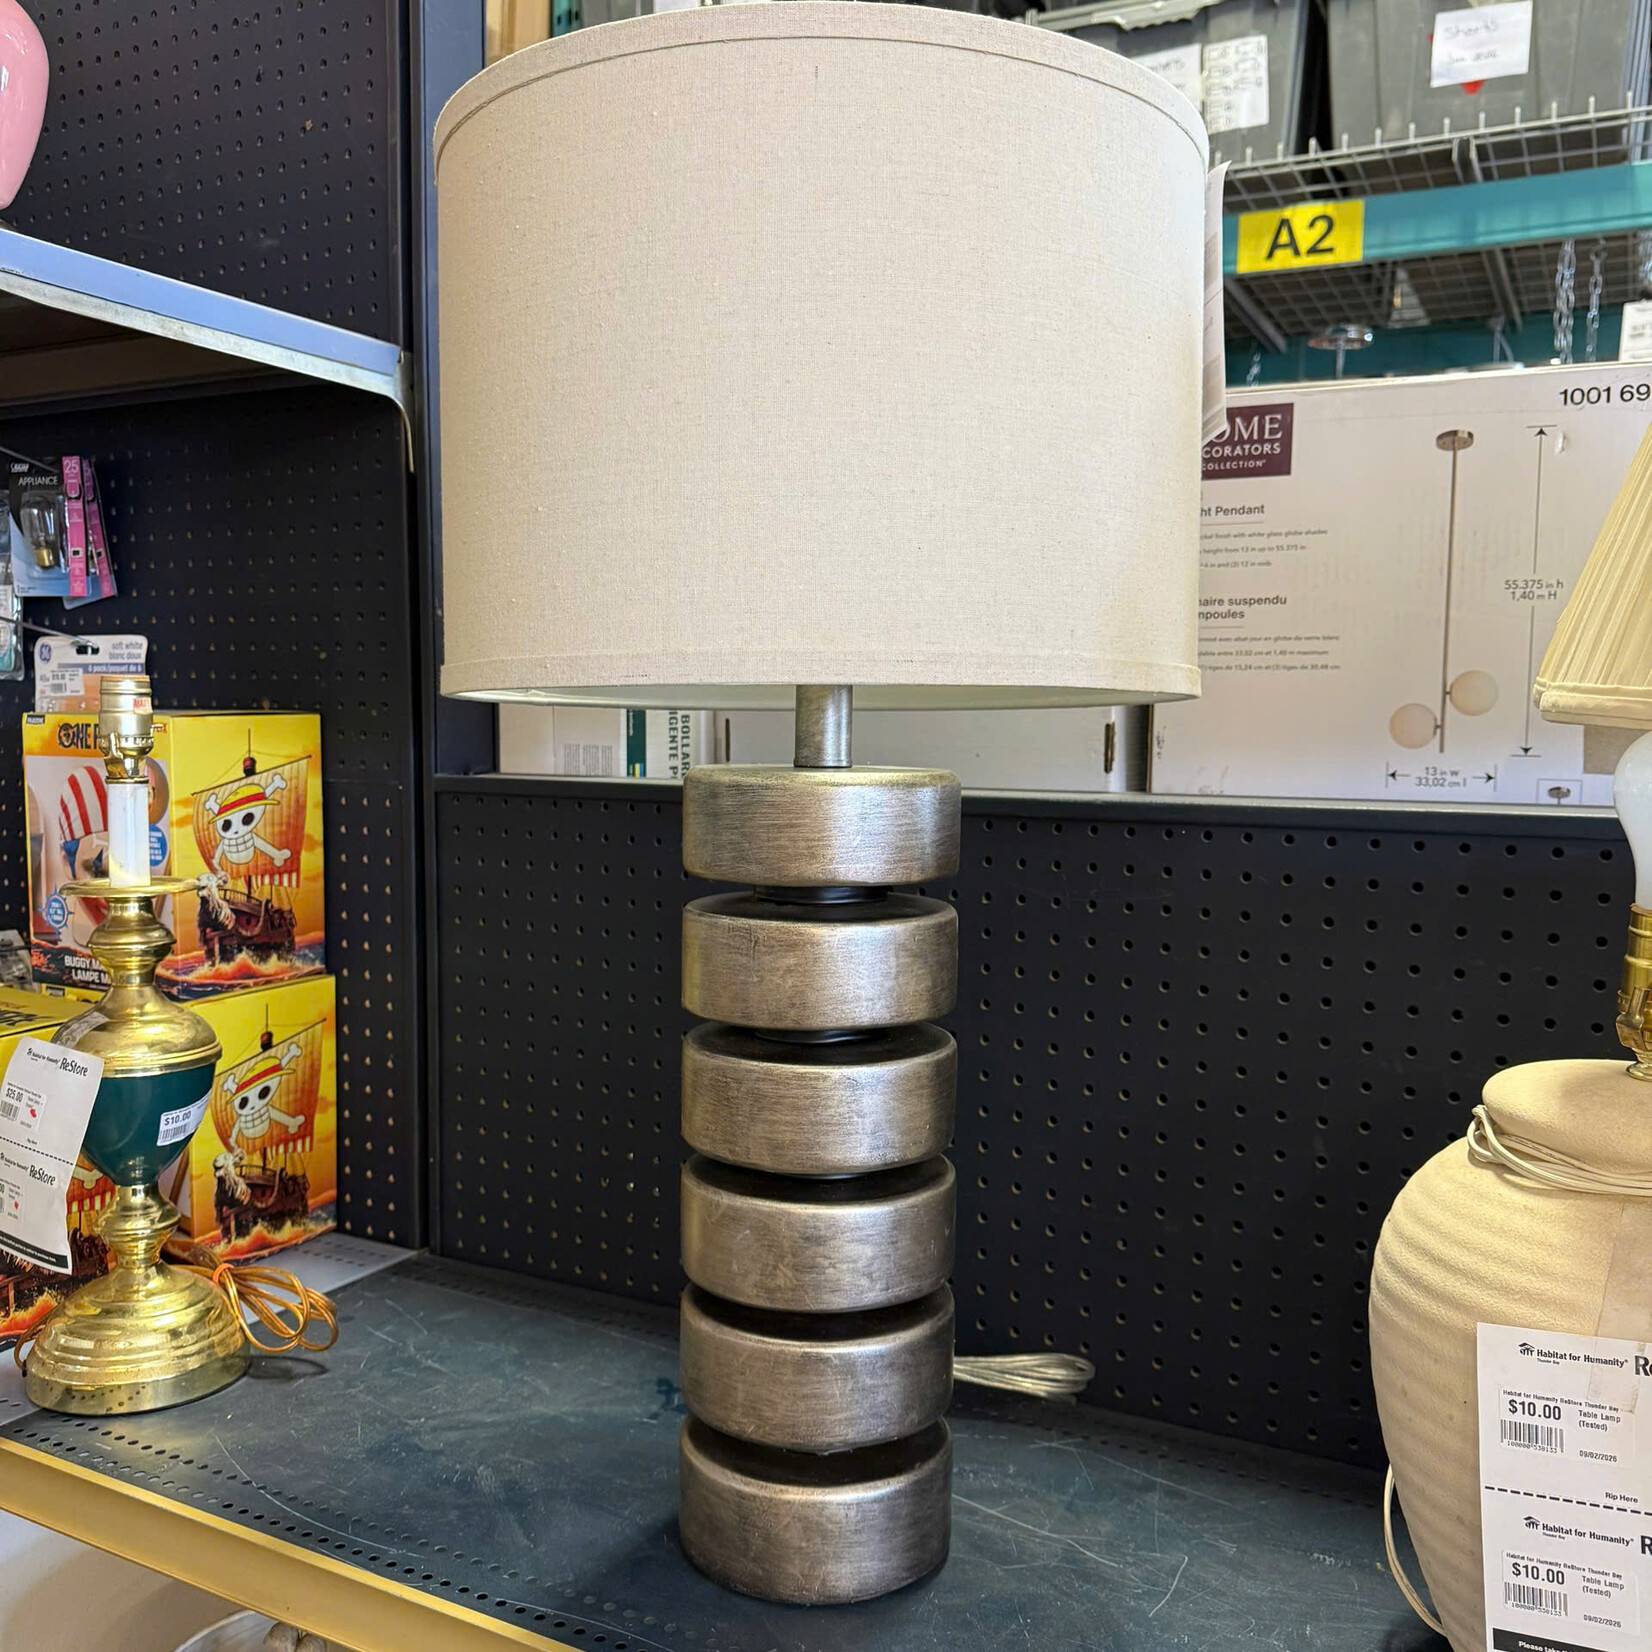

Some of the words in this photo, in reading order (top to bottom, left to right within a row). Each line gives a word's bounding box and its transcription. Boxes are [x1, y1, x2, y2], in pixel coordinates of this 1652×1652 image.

[1265, 215, 1336, 262] A2
[1559, 386, 1612, 406] 1001
[1619, 383, 1651, 402] 69
[64, 459, 79, 473] 25
[18, 475, 58, 486] APPLIANCE
[1215, 504, 1265, 517] Pendant
[1504, 579, 1544, 590] 55.375
[1545, 581, 1554, 589] in
[1556, 579, 1564, 589] h
[1227, 595, 1287, 608] suspendu
[1511, 590, 1535, 602] 1,40
[1548, 590, 1557, 600] H
[112, 642, 124, 650] soft
[125, 641, 143, 650] white
[58, 723, 91, 749] ONE
[668, 766, 679, 779] P
[1425, 767, 1437, 776] 13
[1415, 777, 1447, 788] 33,02
[64, 955, 90, 969] BUGGY
[72, 968, 100, 983] LAMPE
[60, 1057, 88, 1077] ReStore
[6, 1088, 24, 1103] $25.00
[164, 1110, 192, 1126] $10.00
[29, 1164, 56, 1186] ReStore
[1537, 1349, 1567, 1361] Habitat
[1568, 1352, 1581, 1362] for
[1584, 1355, 1625, 1368] Humanity
[1503, 1390, 1522, 1398] Habitat
[1533, 1394, 1558, 1404] Humanity
[1584, 1401, 1607, 1411] Thunder
[1508, 1398, 1562, 1421] $10.00
[1578, 1409, 1598, 1420] Table
[1600, 1412, 1621, 1424] Lamp
[1578, 1420, 1608, 1432] (Tested)
[1579, 1449, 1618, 1463] 09/02/2026
[1605, 1491, 1618, 1501] Rip
[1620, 1493, 1639, 1504] Here
[1542, 1523, 1573, 1536] Habitat
[1574, 1527, 1586, 1538] for
[1589, 1531, 1631, 1547] Humanity
[1506, 1552, 1525, 1561] Habitat
[1588, 1566, 1611, 1577] Thunder
[1512, 1561, 1565, 1585] $10.00
[1582, 1575, 1601, 1585] Table
[1604, 1579, 1625, 1591] Lamp
[1582, 1584, 1612, 1599] (Tested)
[1583, 1614, 1622, 1629] 09/02/2026
[1518, 1640, 1543, 1652] Please
